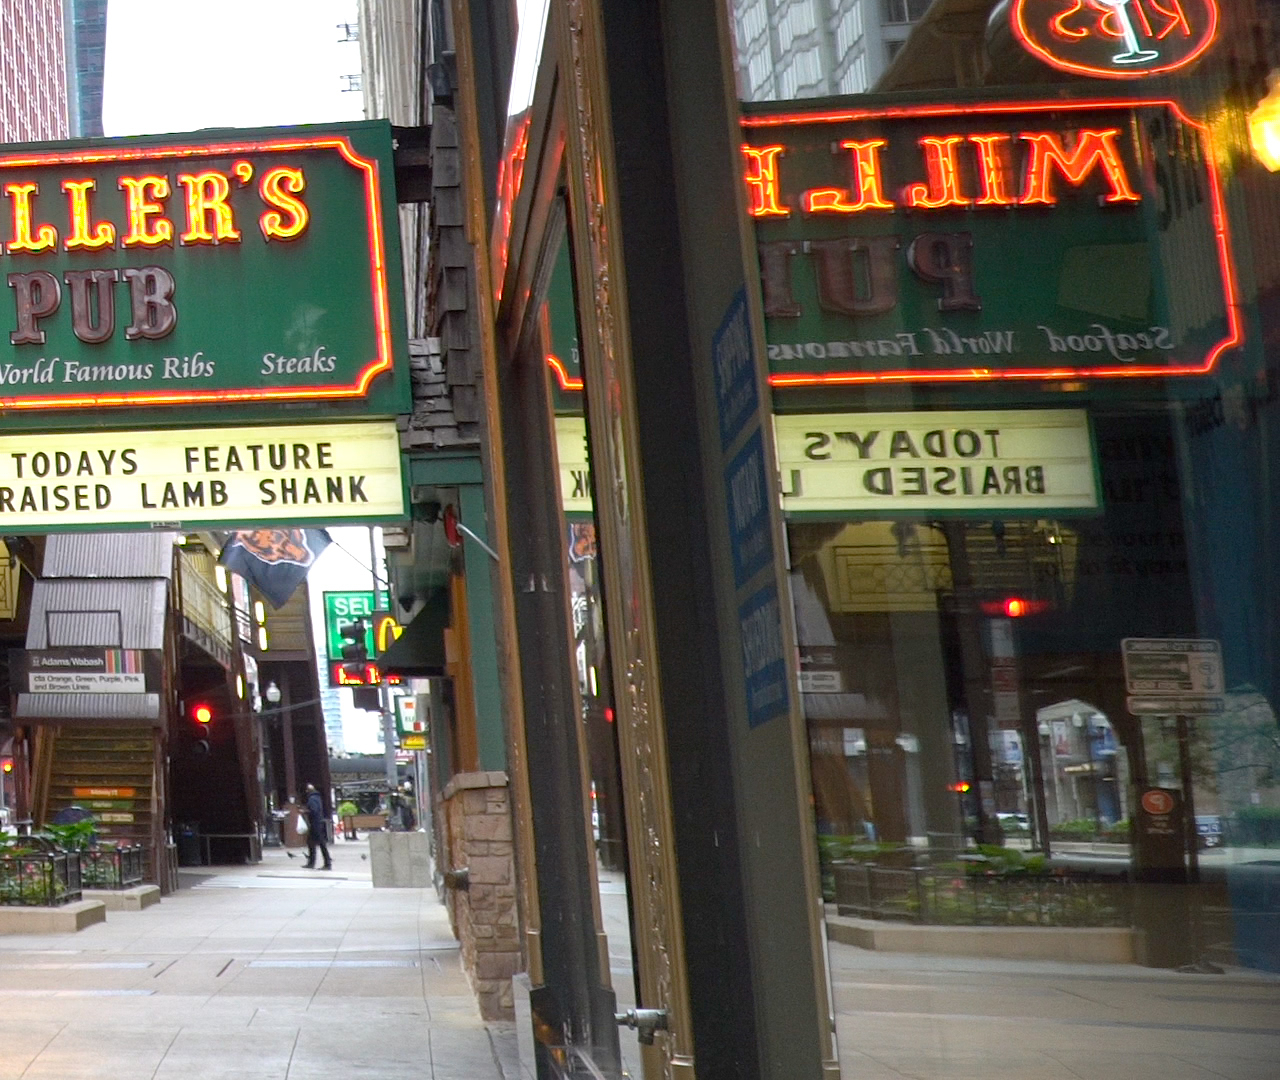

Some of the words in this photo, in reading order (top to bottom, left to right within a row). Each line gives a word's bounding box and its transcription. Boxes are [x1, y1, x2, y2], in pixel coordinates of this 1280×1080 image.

[7, 265, 177, 345] PUB
[62, 359, 154, 384] Famous
[162, 352, 215, 380] Ribs
[261, 345, 337, 375] Steaks
[11, 448, 138, 479] TODAYS
[185, 442, 334, 473] FEATURE
[140, 479, 229, 509] LAMB
[258, 475, 369, 506] SHANK
[334, 597, 388, 616] SEL
[41, 657, 104, 666] Adams/Wabash
